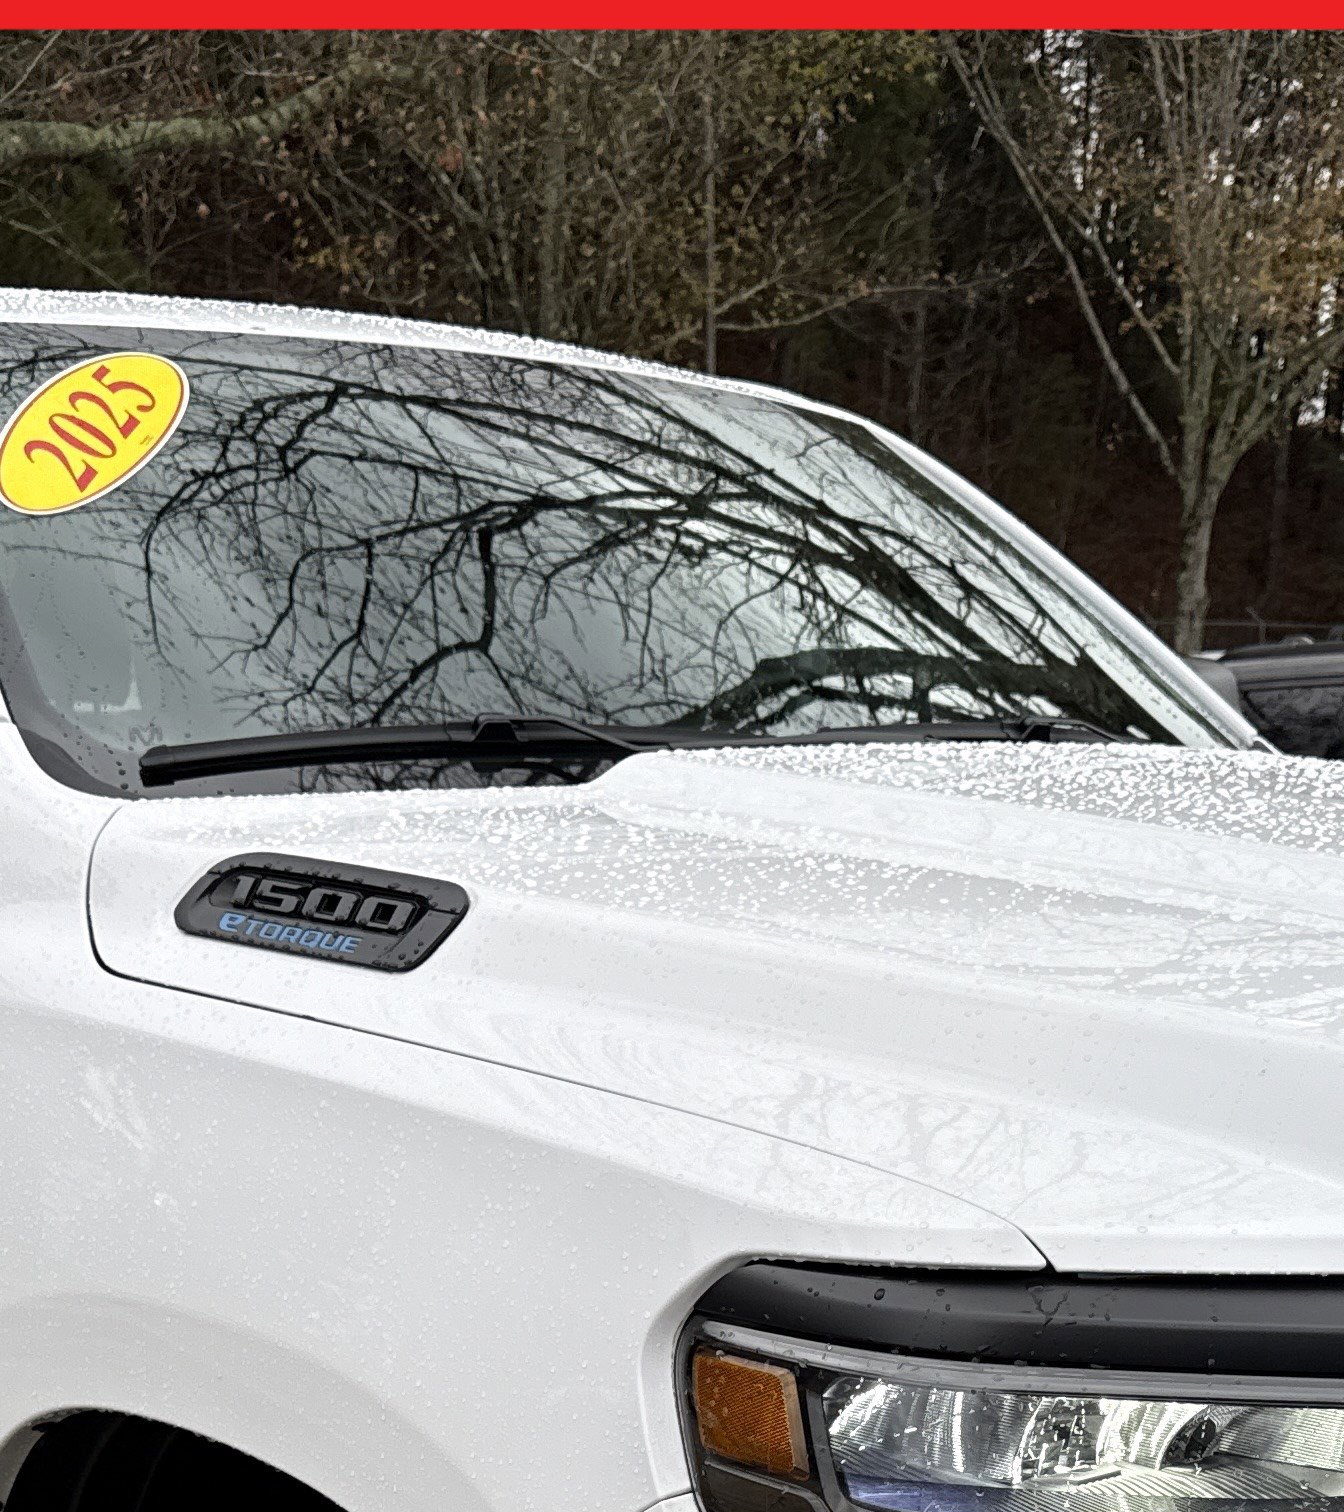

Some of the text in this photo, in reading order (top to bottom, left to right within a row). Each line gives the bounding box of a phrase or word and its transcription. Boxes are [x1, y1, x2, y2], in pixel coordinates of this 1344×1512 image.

[23, 364, 156, 493] 2025
[209, 873, 419, 930] 1500
[218, 911, 364, 955] eTORQUE
